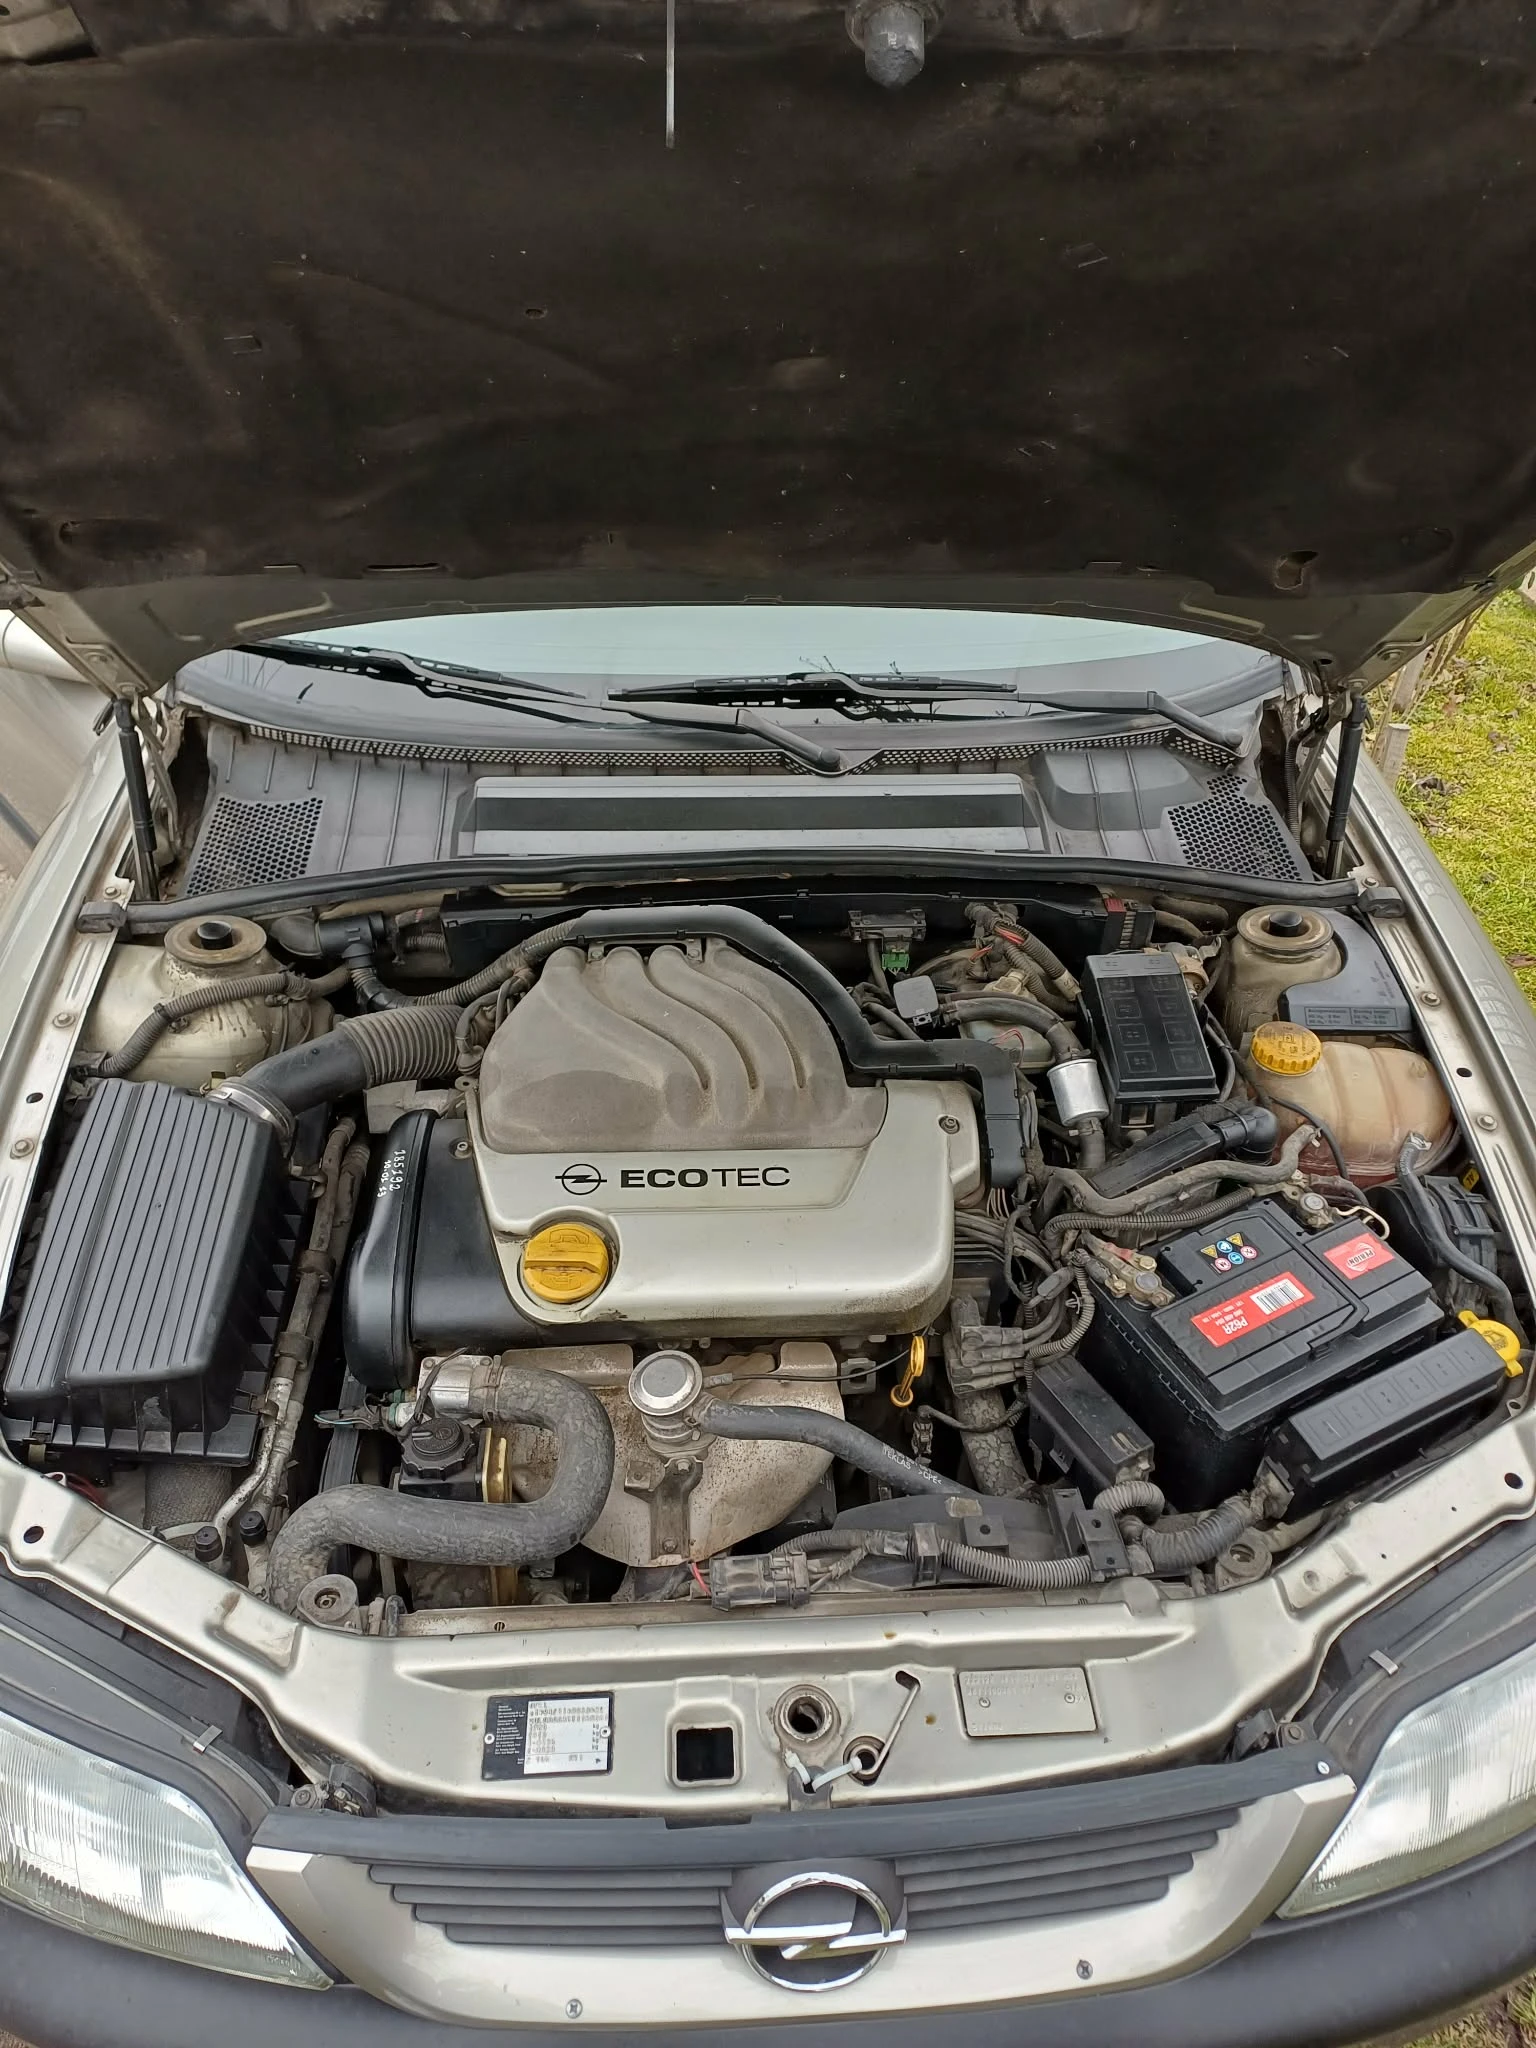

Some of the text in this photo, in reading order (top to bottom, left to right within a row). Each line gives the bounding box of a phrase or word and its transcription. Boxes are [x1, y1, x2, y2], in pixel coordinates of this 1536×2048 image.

[389, 1149, 406, 1191] 185192
[620, 1166, 791, 1188] ECOTEC
[1222, 1316, 1248, 1335] P62R
